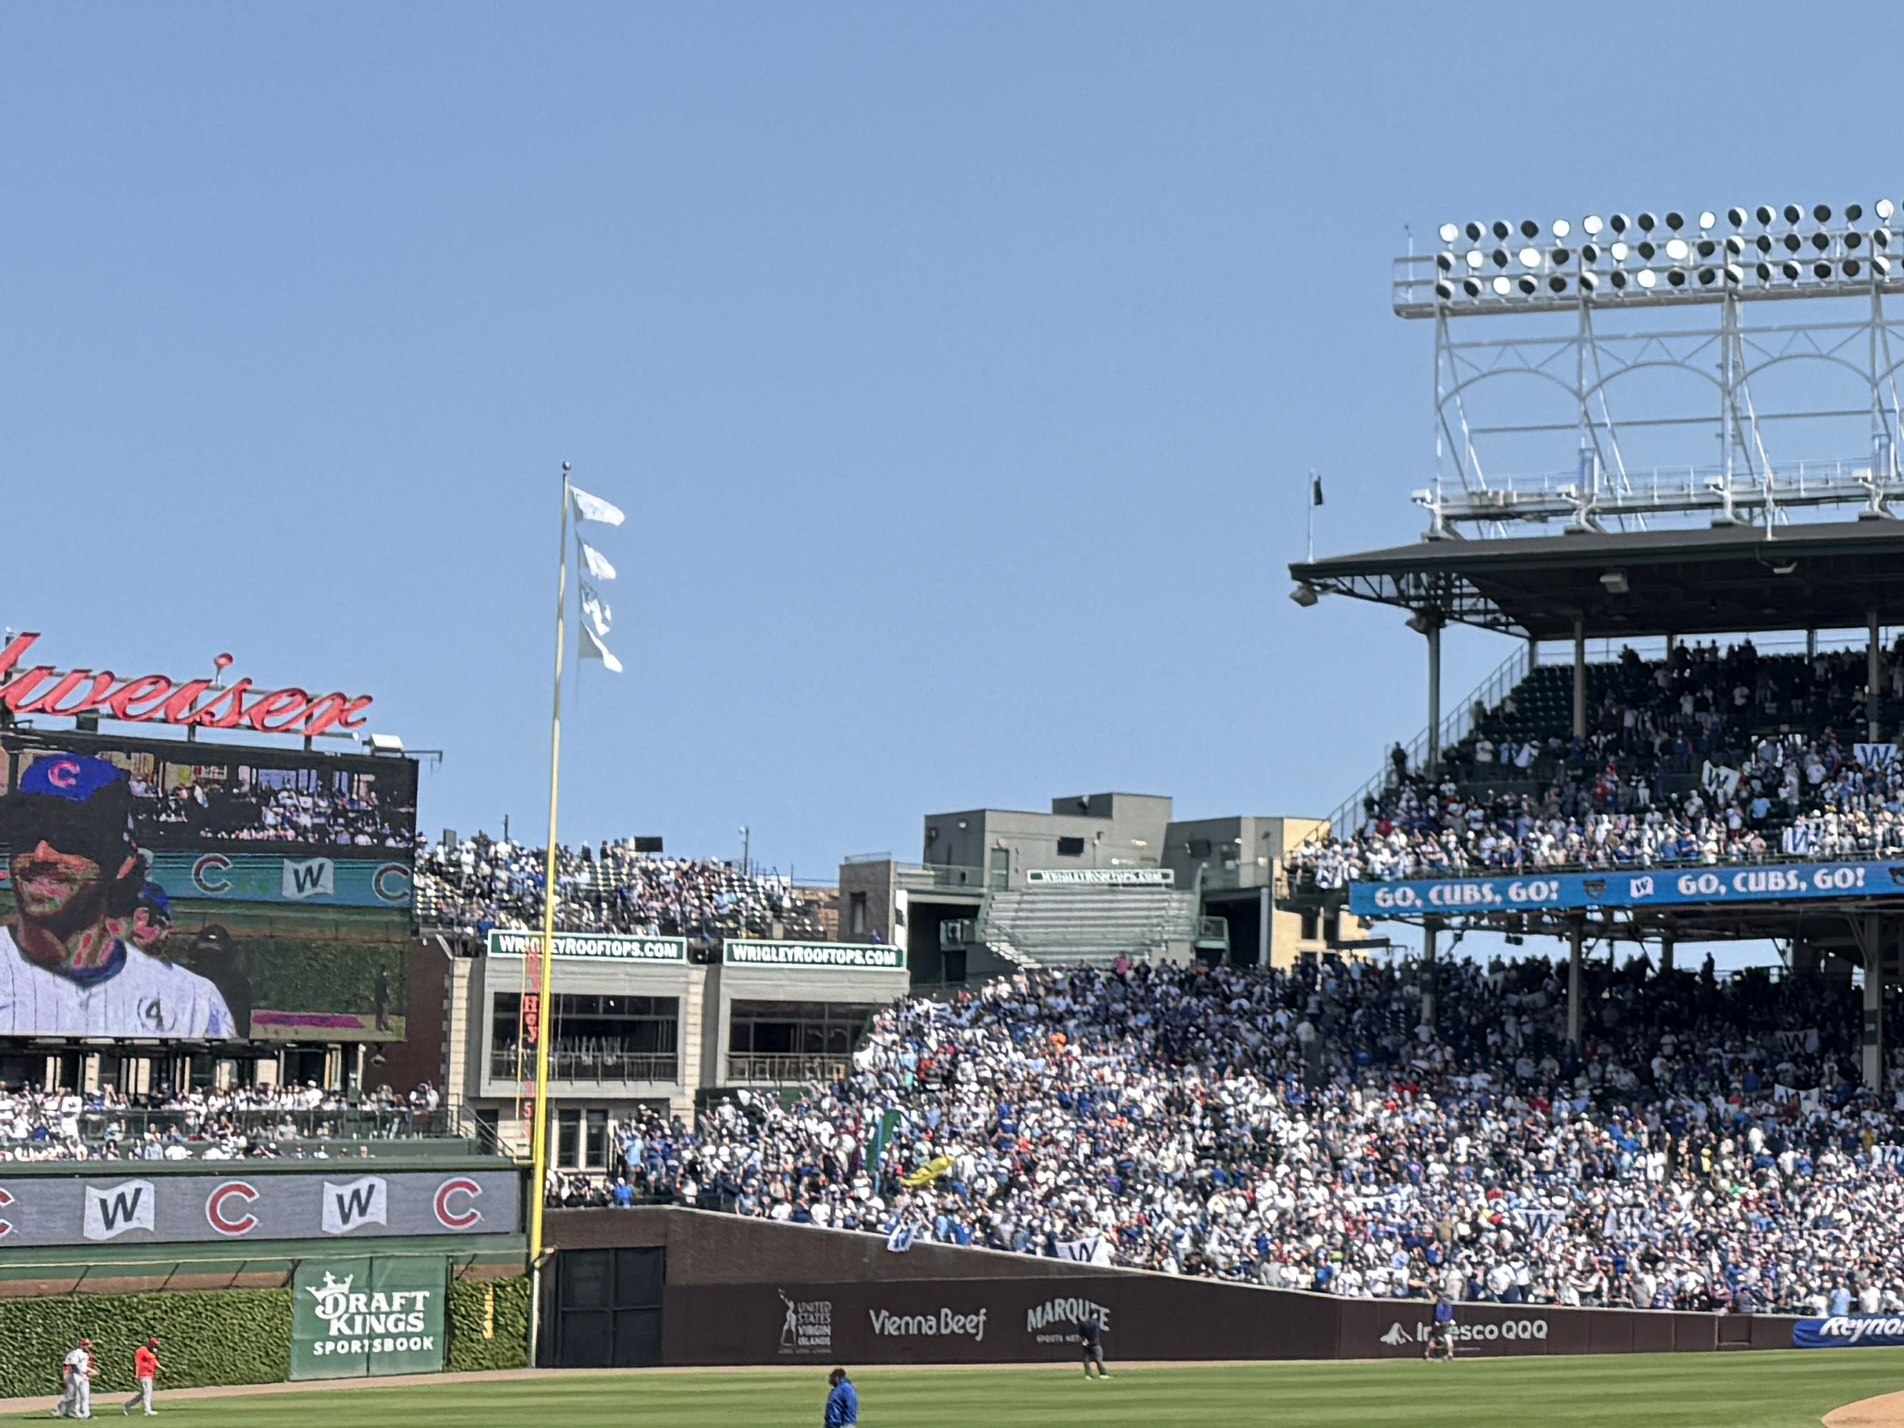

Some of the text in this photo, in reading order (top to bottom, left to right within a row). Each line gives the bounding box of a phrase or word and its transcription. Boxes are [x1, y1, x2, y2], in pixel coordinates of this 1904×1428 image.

[48, 760, 81, 787] C
[193, 853, 410, 901] C W C
[1634, 880, 1651, 895] W
[1678, 868, 1865, 896] GO, CUBS, GO!
[1375, 880, 1558, 909] GO, CUBS, GO!
[499, 935, 678, 958] WRIGEYROOFTOPS.COM
[732, 944, 897, 966] WRIGLEYROOFTOPS.COM
[145, 998, 162, 1031] 4
[100, 1187, 142, 1231] W
[206, 1180, 260, 1236] C
[336, 1184, 375, 1226] W
[433, 1176, 483, 1230] C
[1525, 1212, 1552, 1234] W
[1068, 1239, 1098, 1262] W
[315, 1290, 430, 1319] DRAFT
[798, 1301, 831, 1312] UNITED
[329, 1312, 425, 1336] KINGS
[798, 1312, 831, 1324] STATES
[798, 1325, 831, 1335] VIRGIN
[869, 1307, 987, 1341] Vienna Beef
[1417, 1320, 1548, 1341] Inesco QQQ
[313, 1336, 434, 1356] SPORTSBOOK
